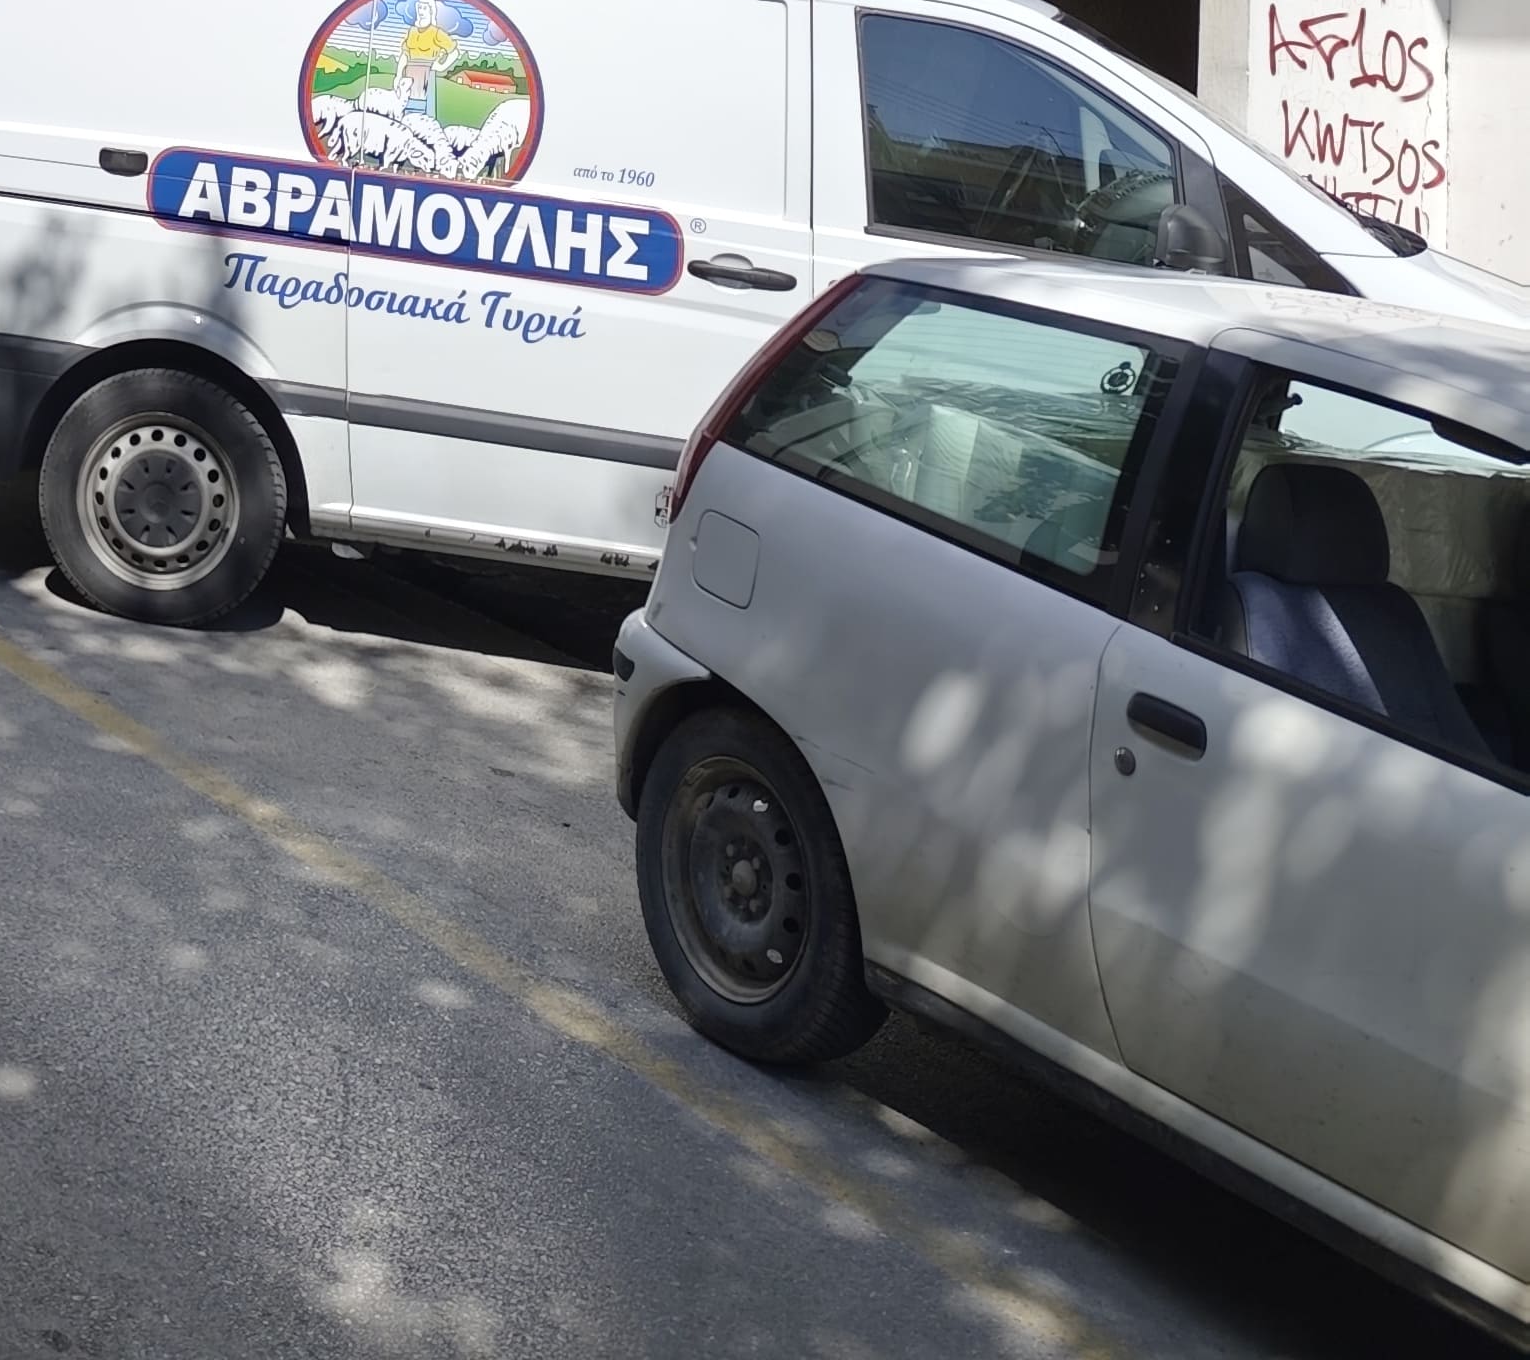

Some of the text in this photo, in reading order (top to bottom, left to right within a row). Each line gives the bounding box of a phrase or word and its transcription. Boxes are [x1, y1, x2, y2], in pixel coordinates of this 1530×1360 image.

[573, 164, 655, 188] από το 1960
[1282, 100, 1446, 195] KWTSOS
[177, 162, 650, 281] ΑΒΡΑΜΟΥΛΗΣ
[224, 252, 586, 344] Παραδοσιακά Τυριά
